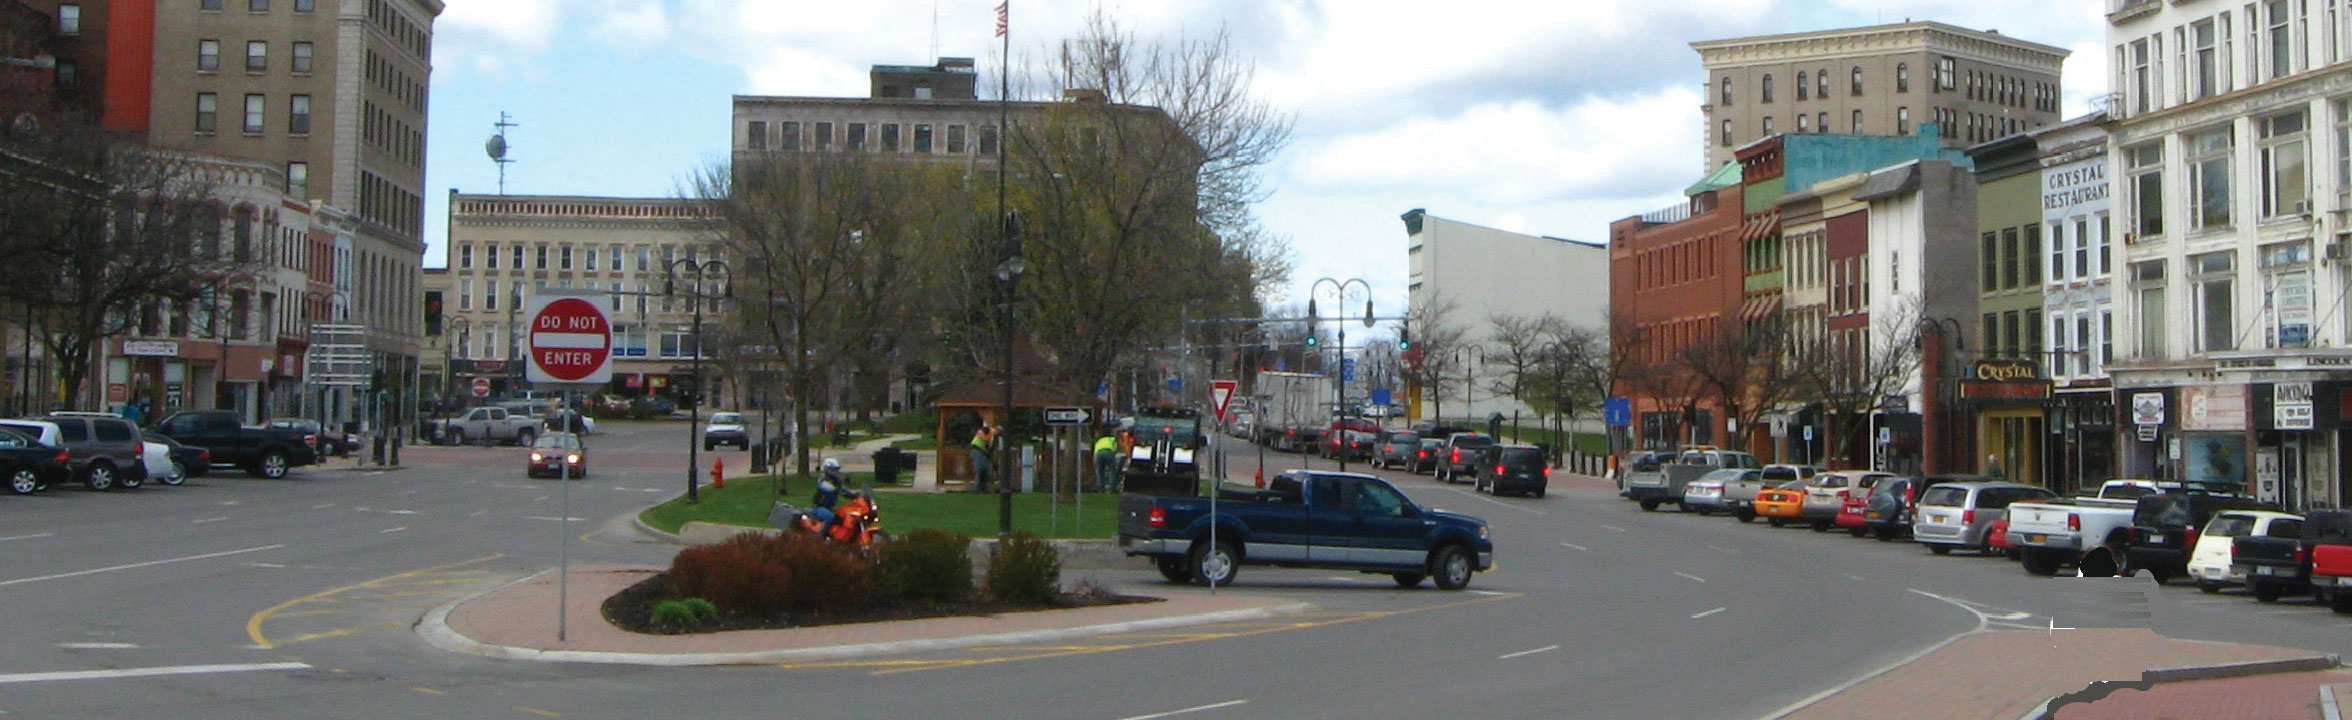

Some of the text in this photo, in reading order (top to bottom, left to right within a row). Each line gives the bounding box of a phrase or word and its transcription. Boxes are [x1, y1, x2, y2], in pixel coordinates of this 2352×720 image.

[2049, 164, 2104, 190] CRYSTAL
[2043, 183, 2110, 209] RESTAURANT
[541, 315, 598, 329] DO NOT
[544, 352, 592, 365] ENTER
[1977, 363, 2036, 381] CRYSTAL
